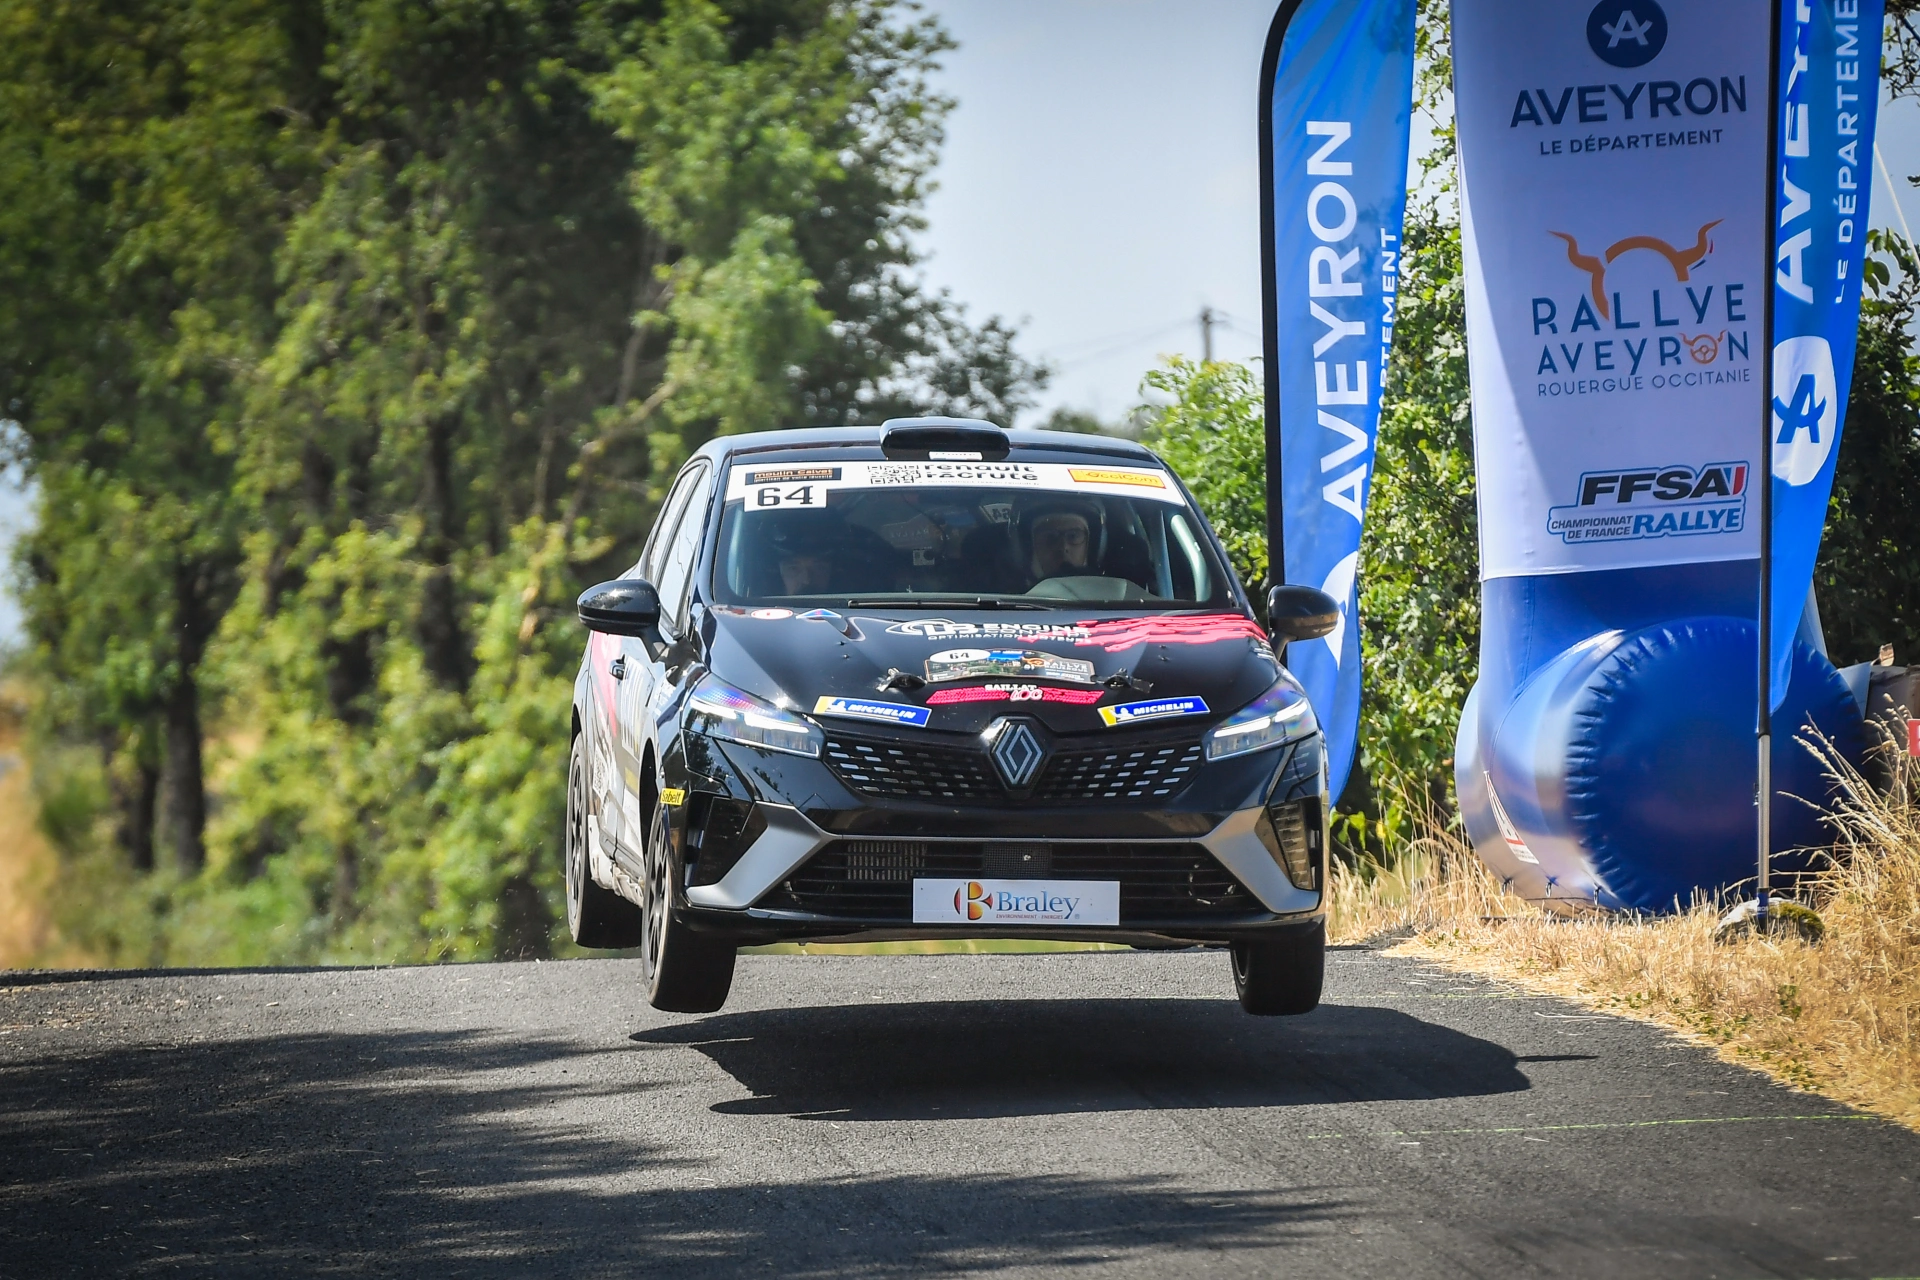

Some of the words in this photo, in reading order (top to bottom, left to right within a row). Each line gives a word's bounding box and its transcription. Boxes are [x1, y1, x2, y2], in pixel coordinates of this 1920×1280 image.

[1510, 75, 1747, 128] AVEYRON
[1541, 140, 1562, 156] LE
[1570, 129, 1724, 154] DÉPARTEMENT
[1835, 259, 1848, 303] LE
[1306, 121, 1368, 525] AVEYRON
[1532, 283, 1747, 336] RALLYE
[1537, 329, 1750, 376] AVEYRON
[1538, 376, 1644, 397] ROUERGUE
[1652, 369, 1750, 389] OCCITANIE
[757, 485, 814, 507] 64
[1581, 468, 1731, 506] FFSA
[1551, 515, 1634, 530] CHAMPIONNAT
[1632, 508, 1742, 535] RALLYE
[1567, 530, 1582, 540] DE
[1585, 526, 1631, 538] FRANCE
[949, 652, 970, 660] 64
[847, 704, 917, 719] MICHELIN
[1133, 701, 1194, 716] MICHELIN
[996, 890, 1080, 919] Braley
